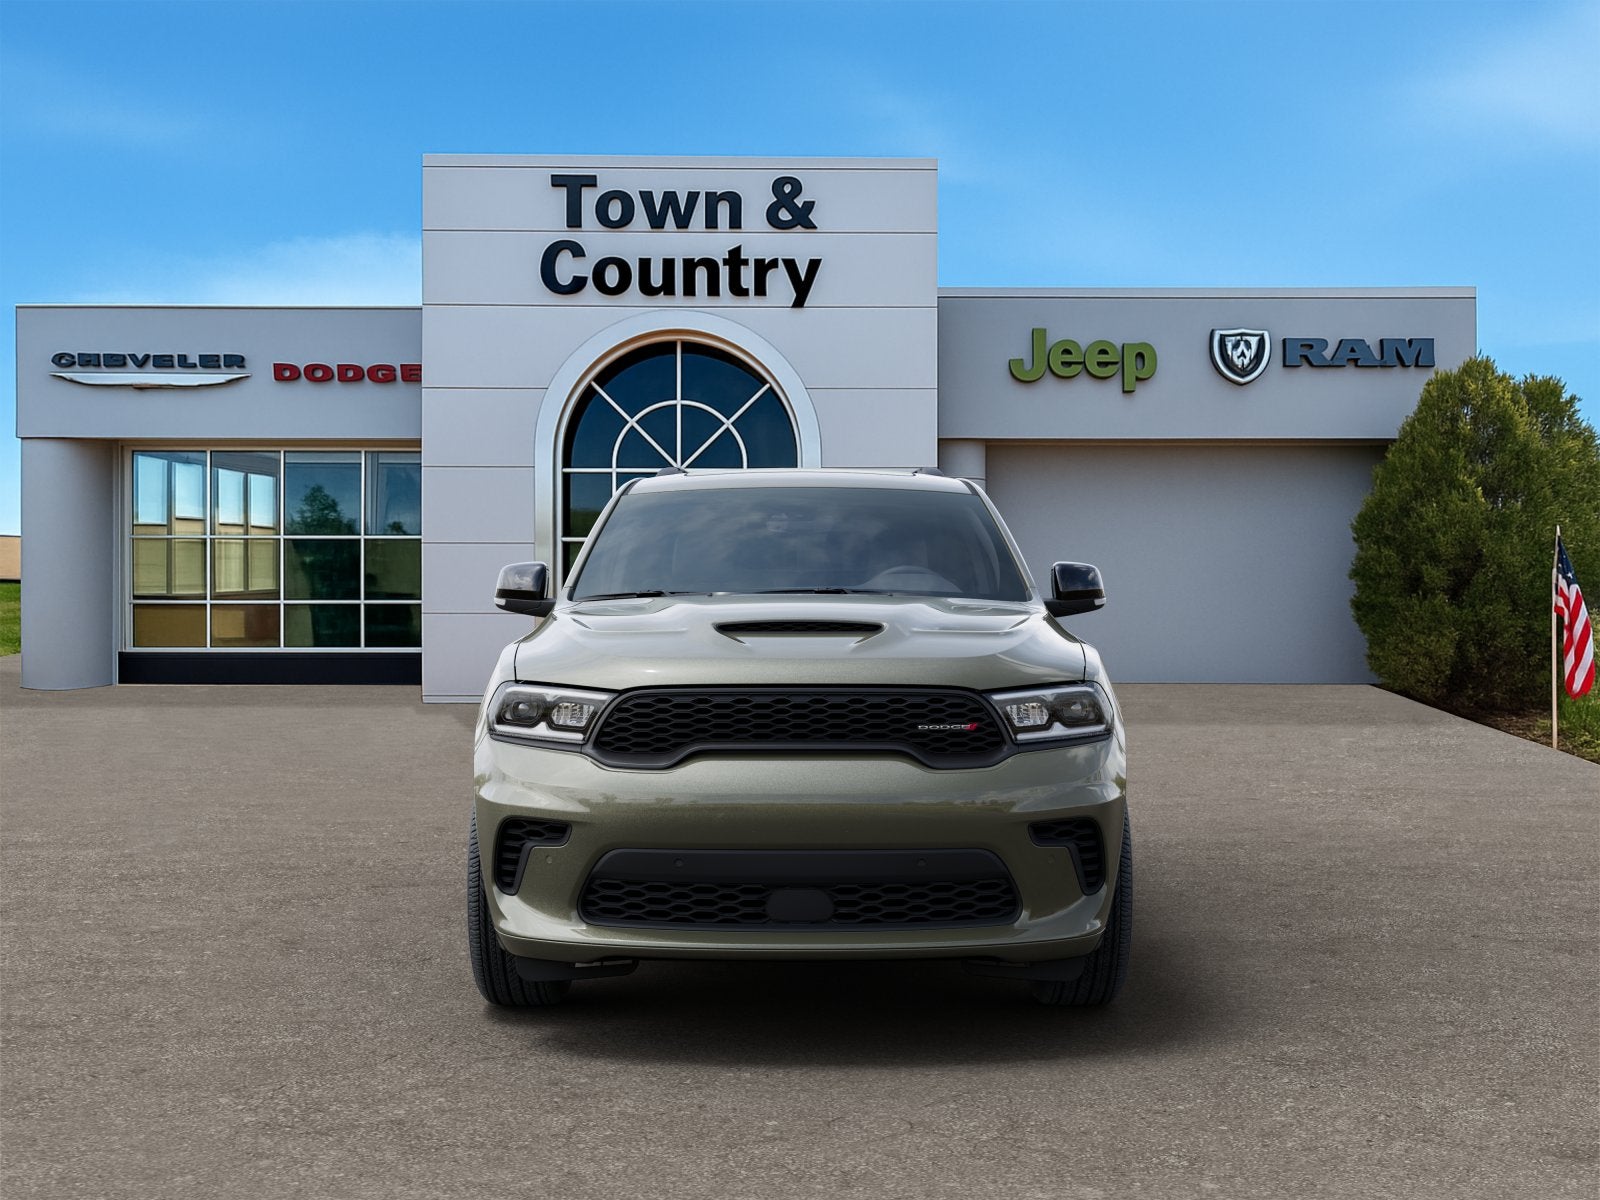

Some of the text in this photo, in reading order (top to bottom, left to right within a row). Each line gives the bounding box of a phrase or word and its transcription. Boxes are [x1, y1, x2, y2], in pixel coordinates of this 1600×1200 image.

[551, 175, 818, 229] Town &
[540, 240, 822, 308] Country
[273, 363, 422, 383] DODGE
[1009, 328, 1158, 393] Jeep
[1283, 337, 1436, 367] RAM
